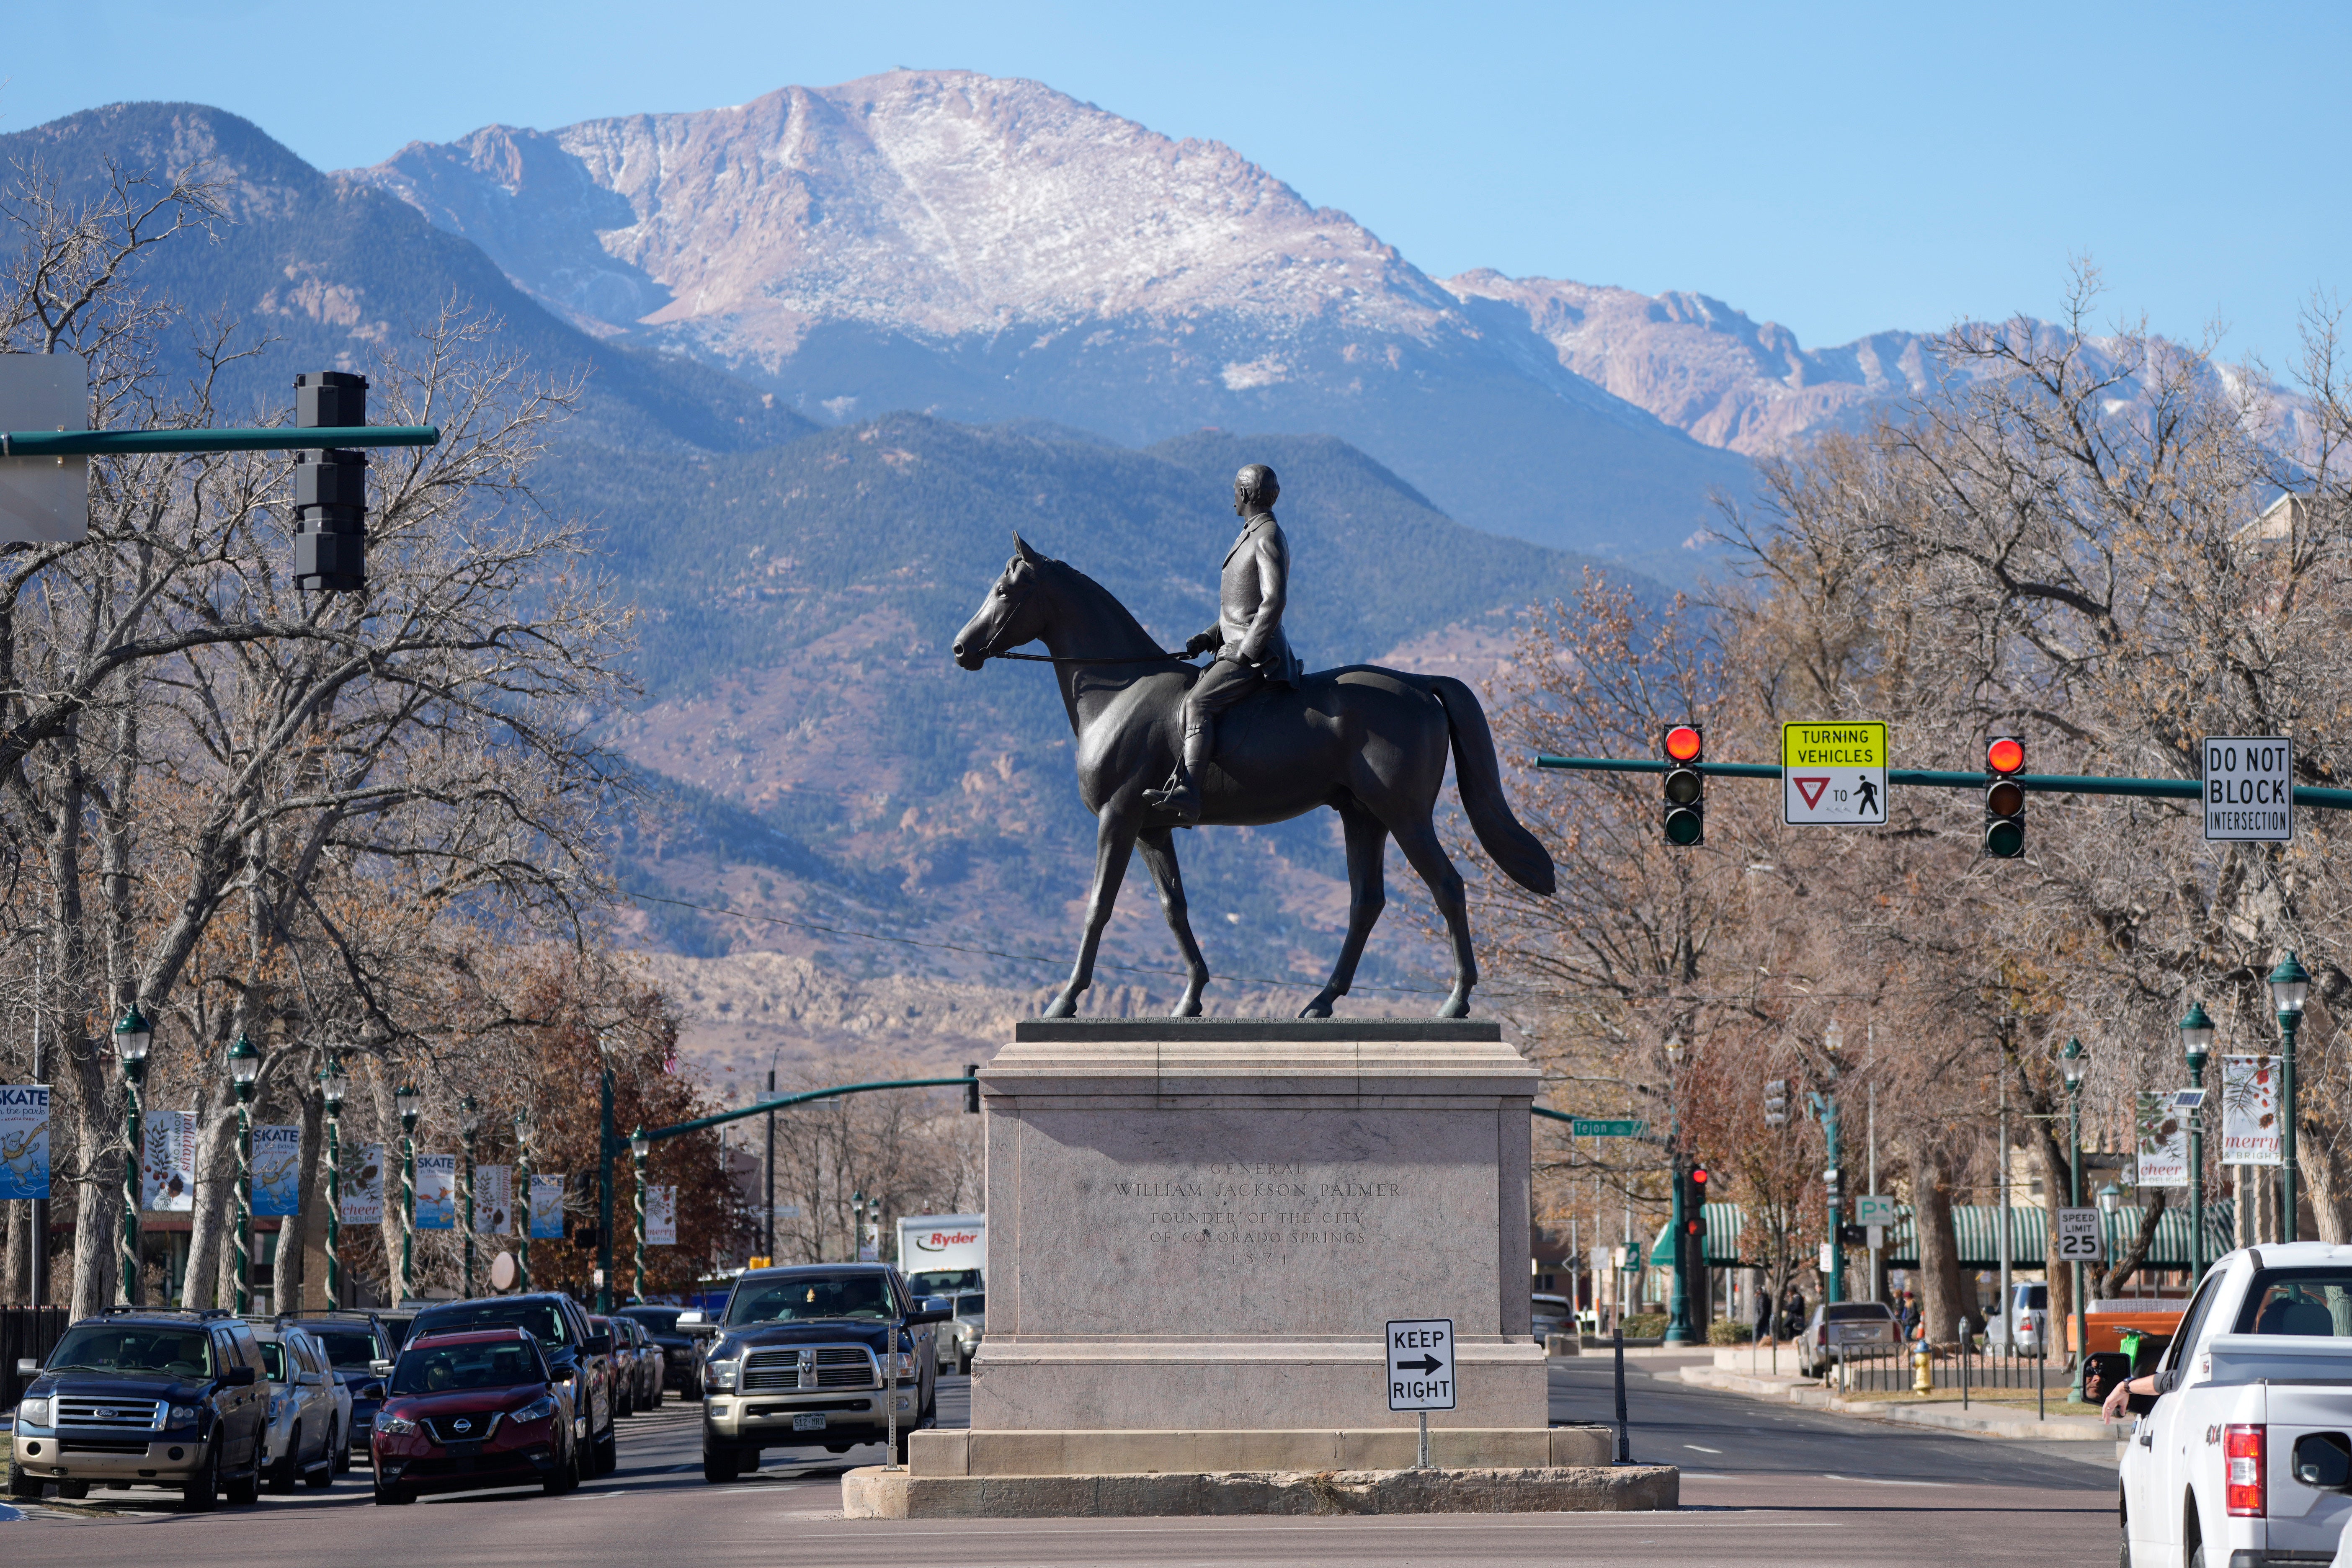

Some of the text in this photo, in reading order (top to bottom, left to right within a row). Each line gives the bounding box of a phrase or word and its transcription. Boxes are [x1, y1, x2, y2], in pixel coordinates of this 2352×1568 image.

[1802, 730, 1868, 743] TURNING
[1798, 750, 1873, 763] VEHICLES
[2210, 748, 2285, 771] DO NOT
[1833, 790, 1847, 802] TO
[2210, 779, 2285, 804] BLOCK
[2210, 812, 2285, 830] INTERSECTION
[0, 1090, 48, 1106] KATE
[7, 1106, 21, 1114] the
[23, 1106, 45, 1117] park
[253, 1129, 299, 1142] SKATE
[1577, 1123, 1607, 1135] Tejon
[180, 1114, 195, 1171] holidays
[2223, 1137, 2278, 1152] merry
[418, 1157, 454, 1168] SKATE
[1211, 1163, 1306, 1174] GENERAL
[2141, 1163, 2182, 1176] cheer
[1115, 1184, 1403, 1197] WILLIAM JACKSON PALMER
[343, 1204, 378, 1215] cheer
[1862, 1201, 1877, 1219] P
[1152, 1213, 1364, 1224] FOUNDER OF THE CITY
[931, 1232, 977, 1247] Ryder
[1150, 1232, 1365, 1243] OF COLORADO SPRINGS
[2063, 1235, 2096, 1253] 25
[1231, 1251, 1287, 1265] 1871
[1395, 1331, 1444, 1348] KEEP
[1393, 1381, 1449, 1398] RIGHT
